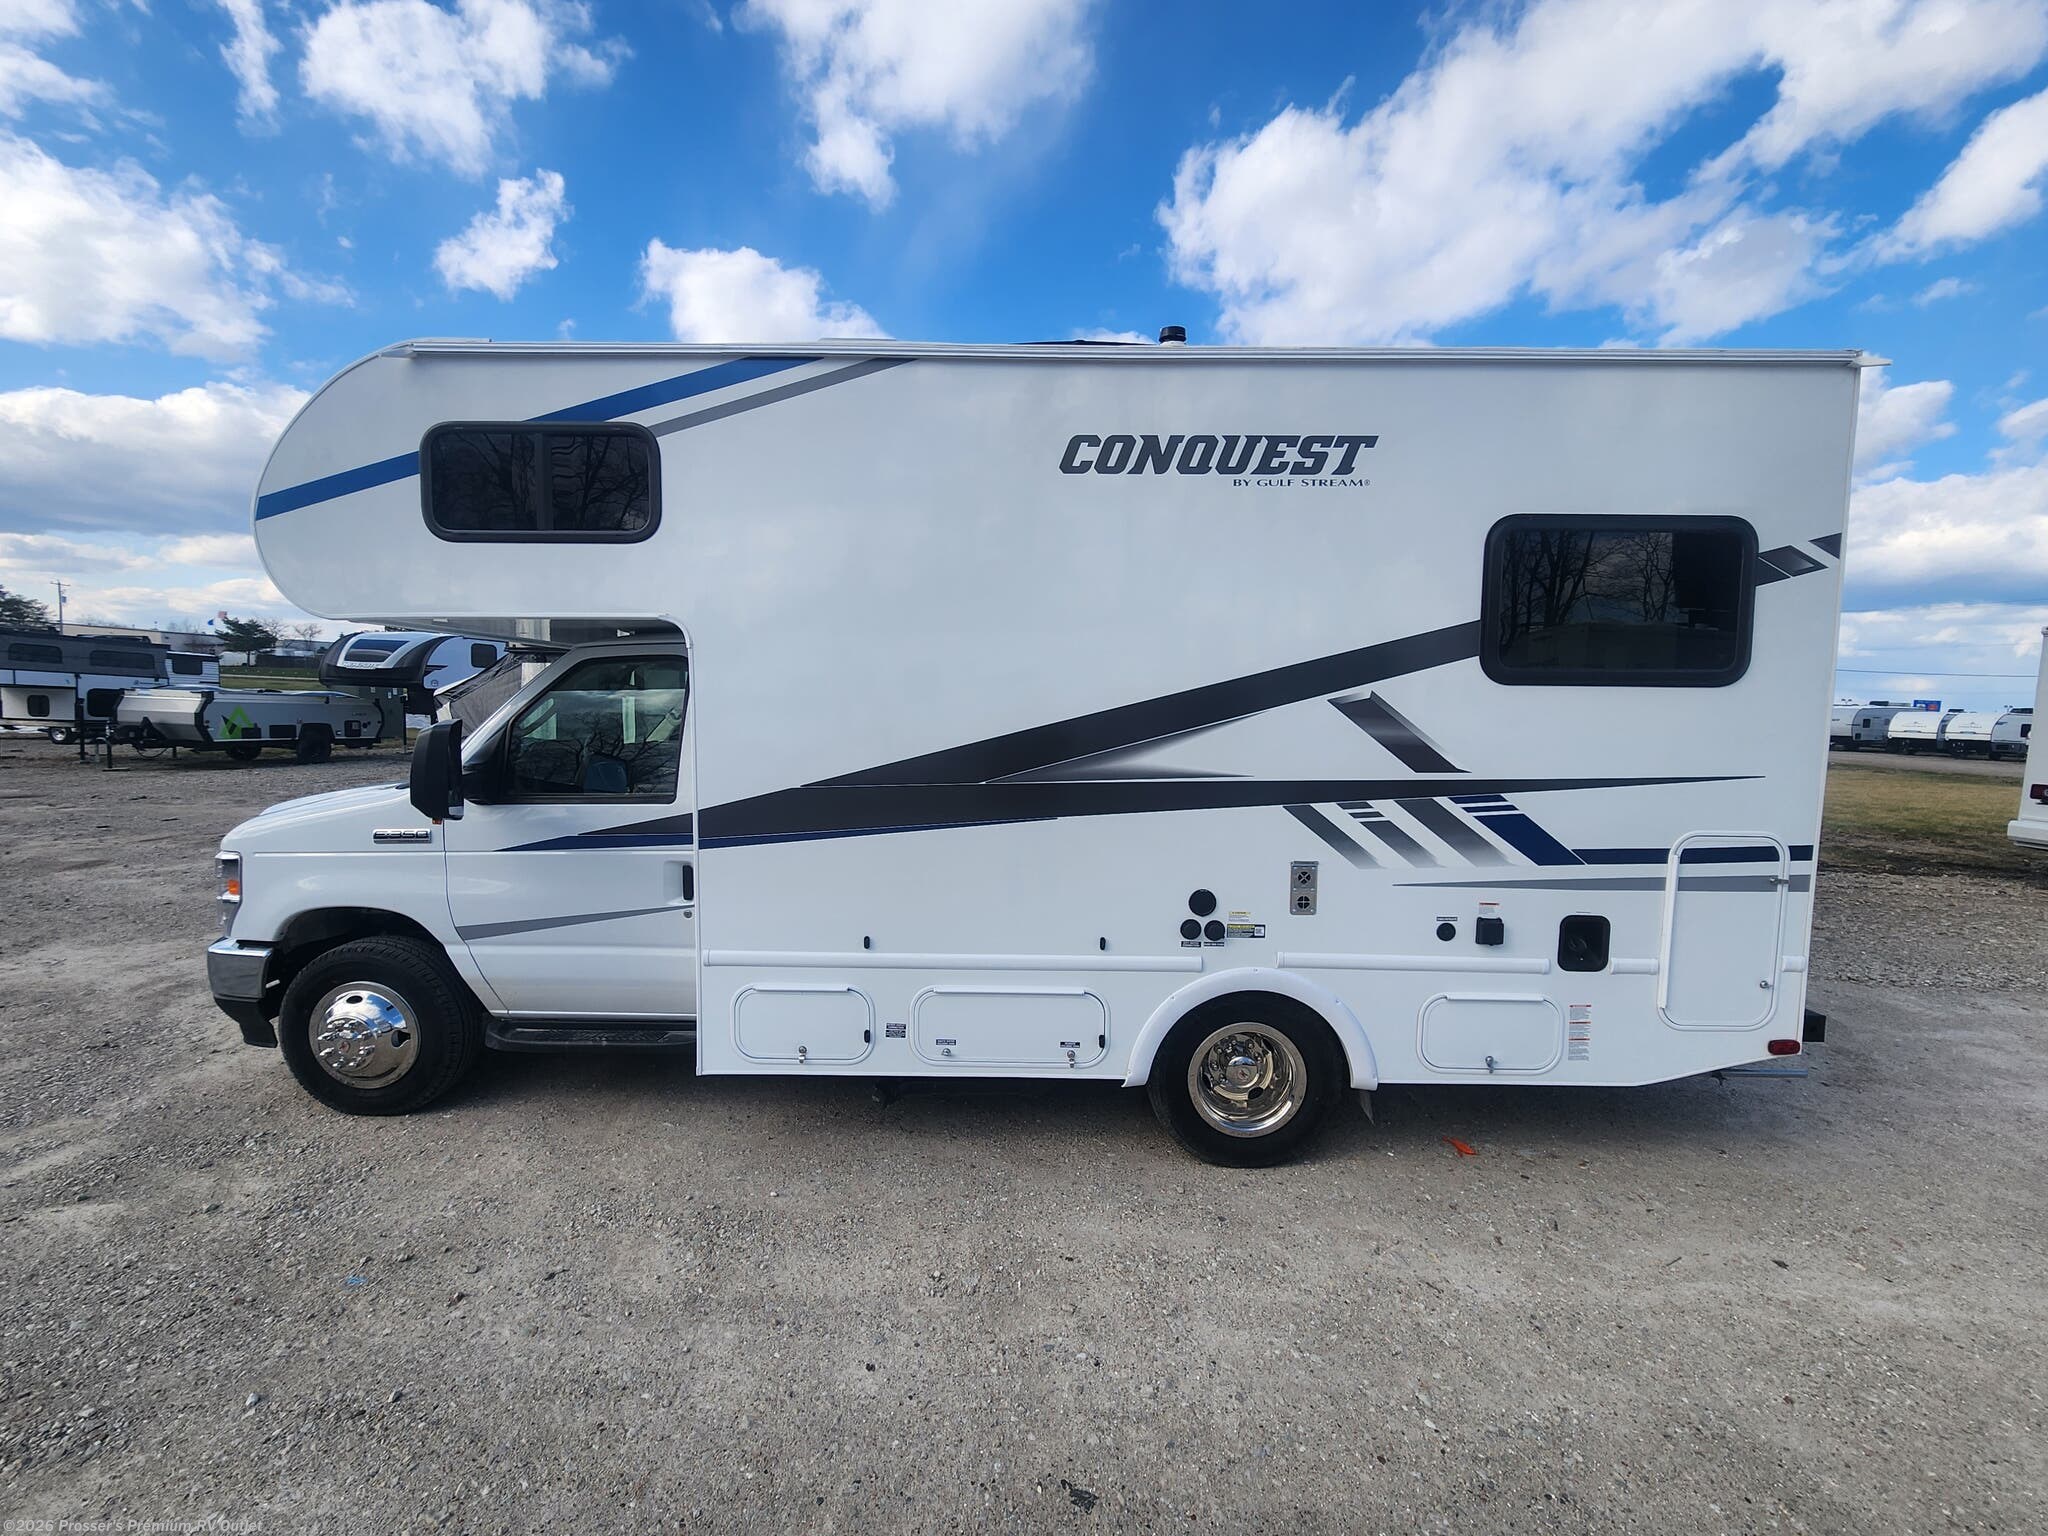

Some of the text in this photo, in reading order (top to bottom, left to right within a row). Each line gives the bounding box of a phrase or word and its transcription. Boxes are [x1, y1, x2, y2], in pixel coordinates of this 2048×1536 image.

[1059, 434, 1379, 475] CONQUEST
[1233, 479, 1252, 487] BY
[1256, 479, 1295, 487] GULF
